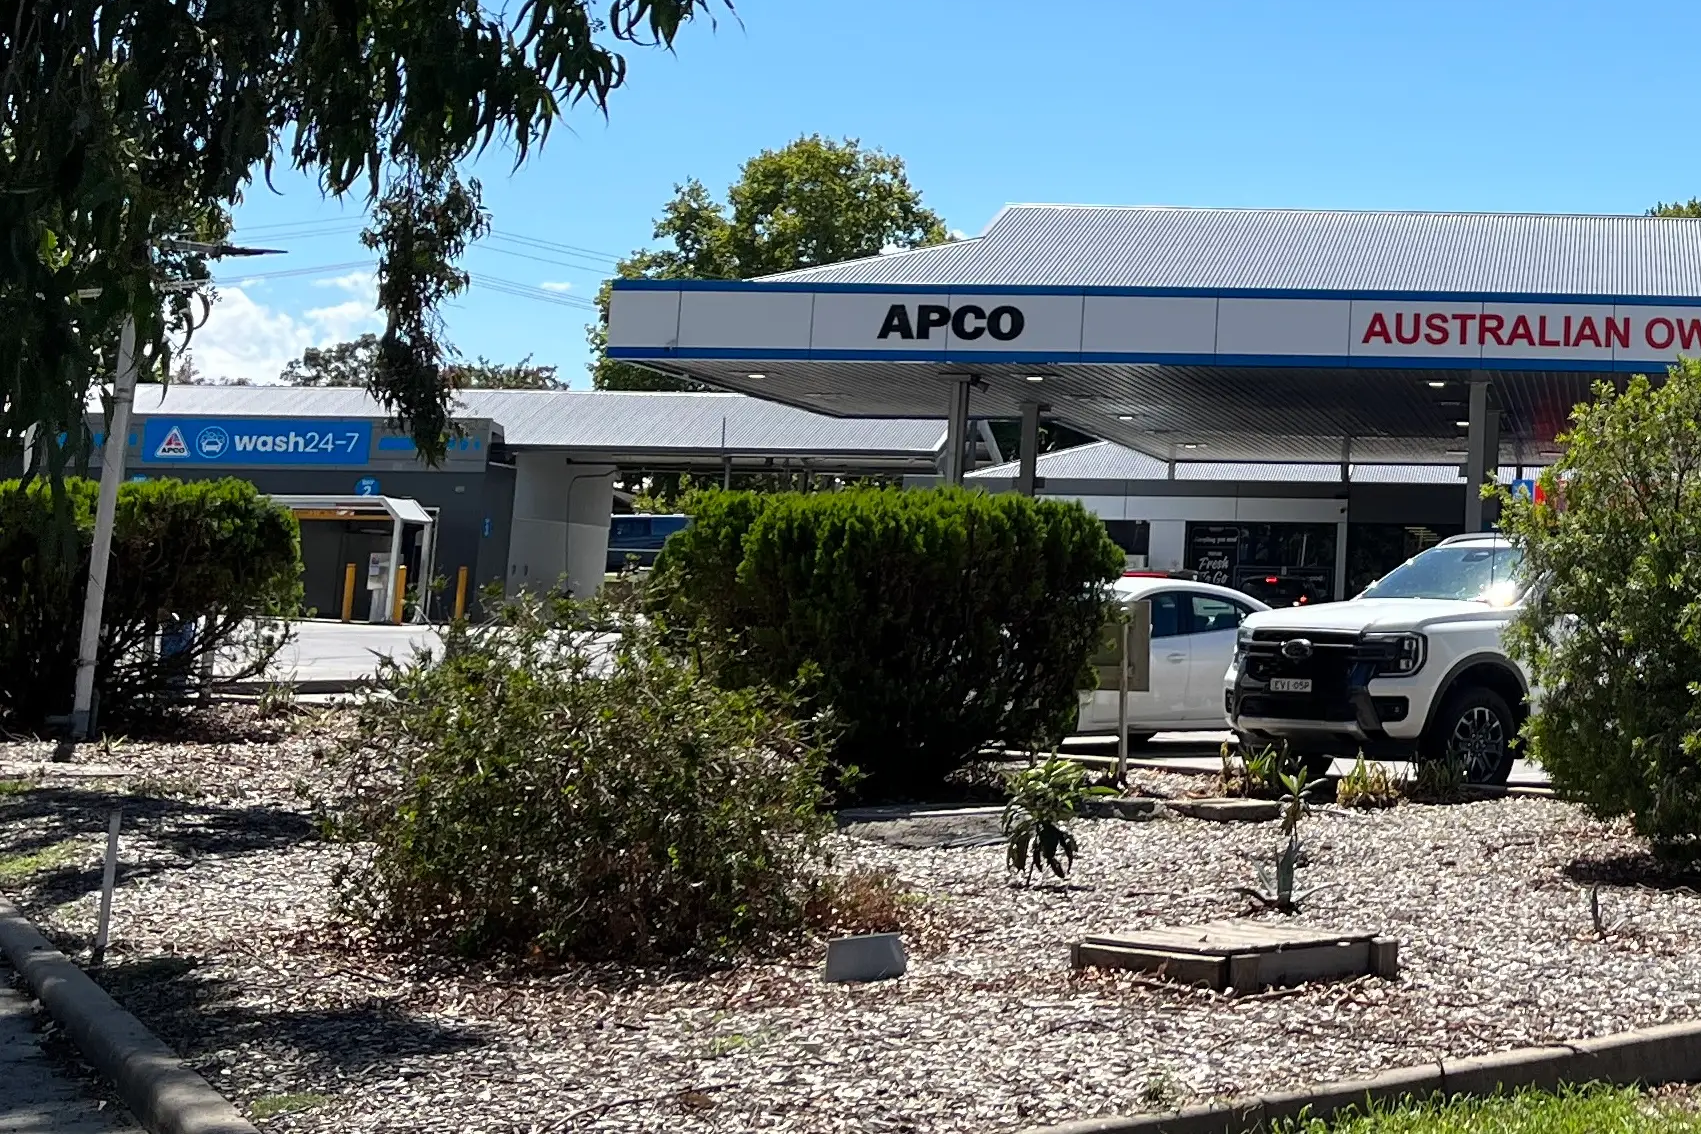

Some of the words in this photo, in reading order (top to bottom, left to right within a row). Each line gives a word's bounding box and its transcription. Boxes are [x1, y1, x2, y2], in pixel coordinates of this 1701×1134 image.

[877, 303, 1025, 341] APCO
[1362, 312, 1631, 349] AUSTRALIAN
[161, 446, 185, 454] APCO
[363, 485, 372, 496] 2
